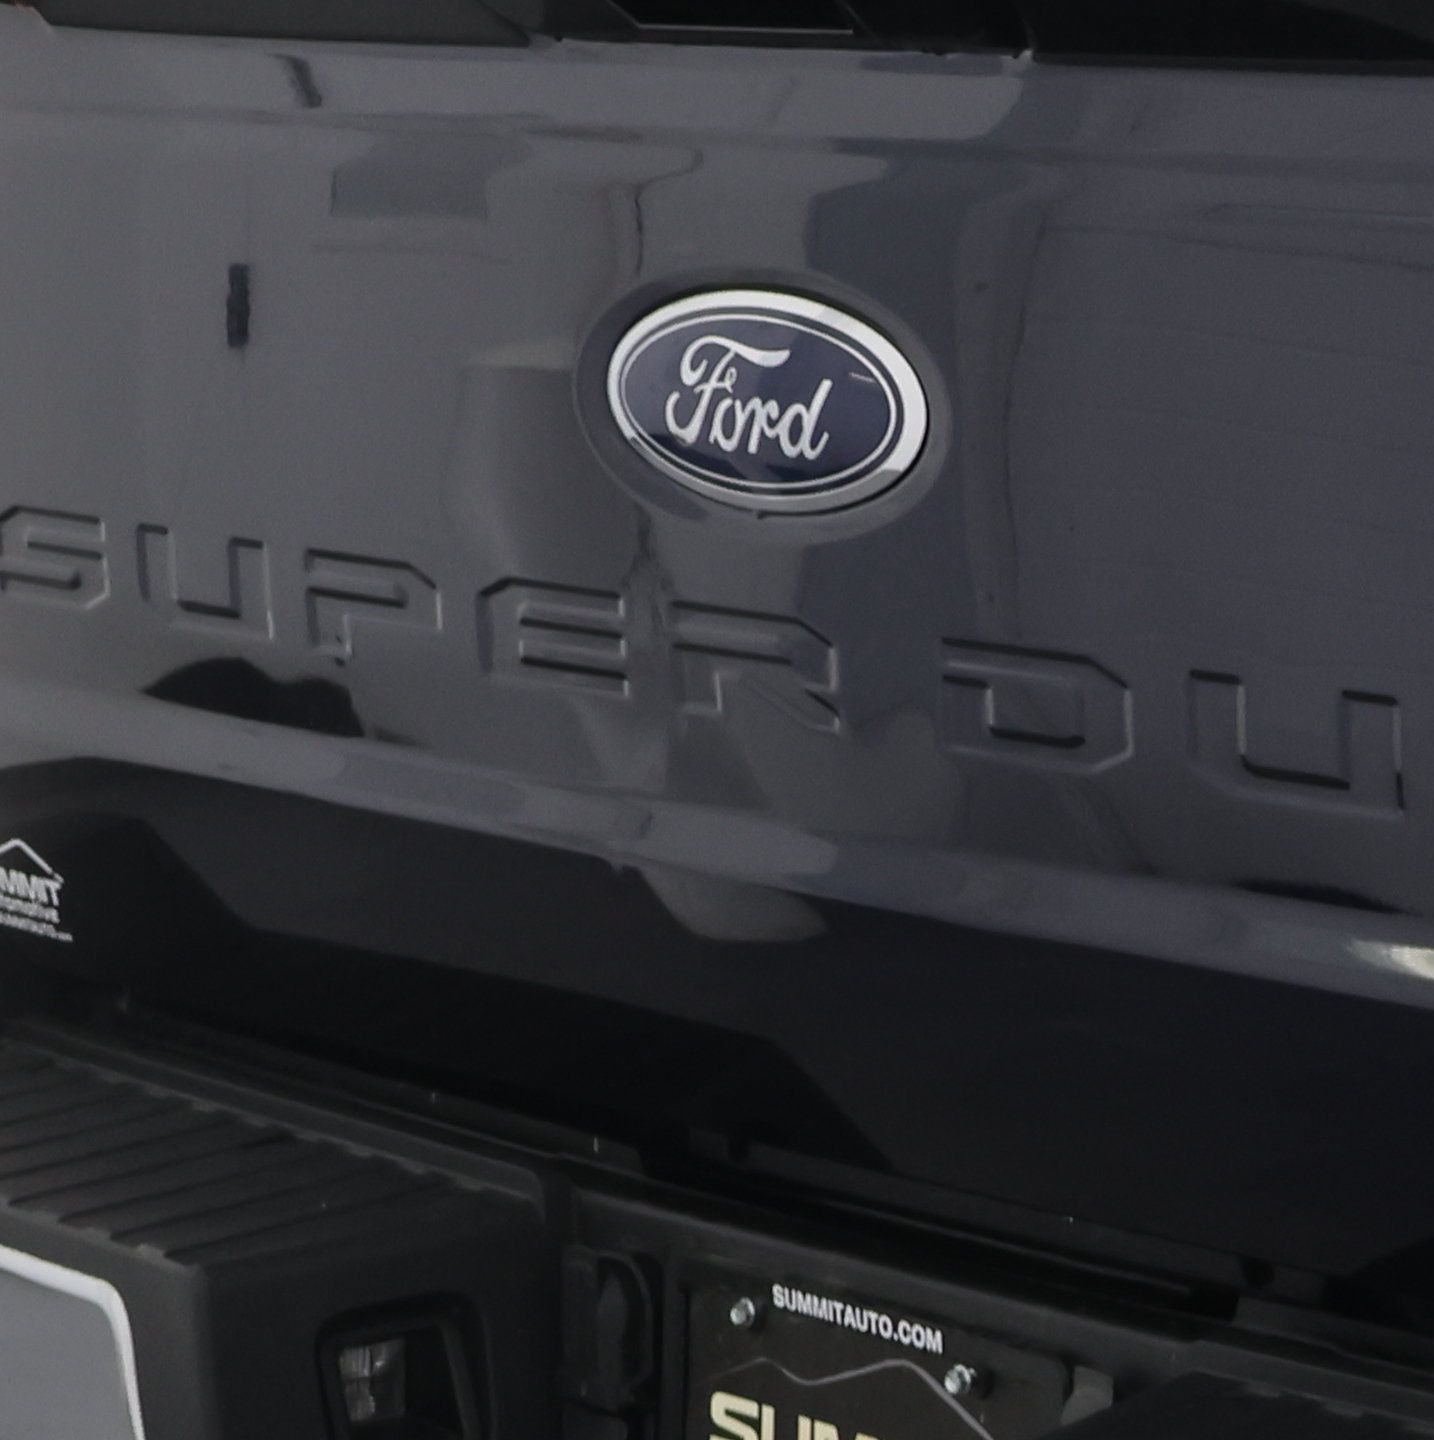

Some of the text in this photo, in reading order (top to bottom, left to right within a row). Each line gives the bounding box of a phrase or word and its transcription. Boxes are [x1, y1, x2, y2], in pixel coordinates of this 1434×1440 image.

[663, 332, 833, 462] Ford
[0, 504, 844, 736] SUPER
[772, 1283, 943, 1355] SUMMITAUTO.COM
